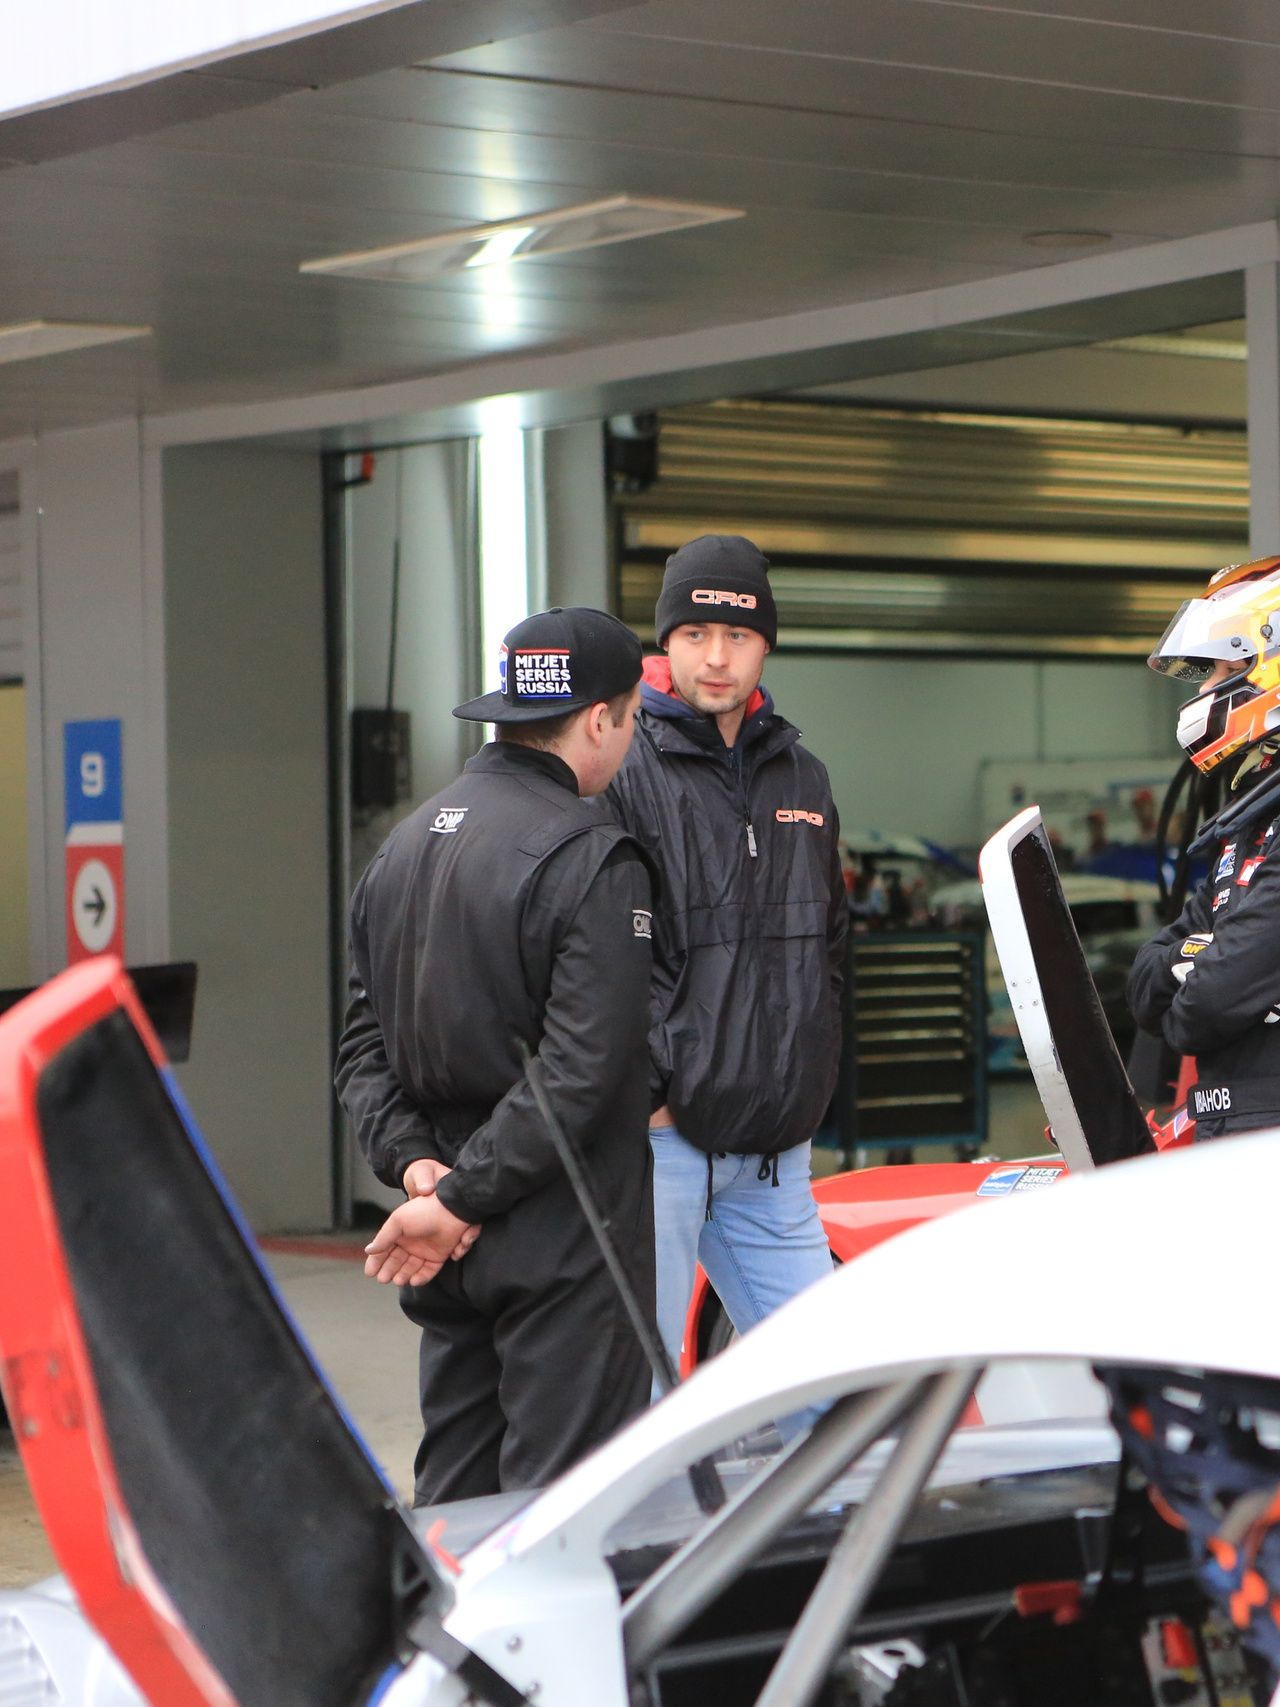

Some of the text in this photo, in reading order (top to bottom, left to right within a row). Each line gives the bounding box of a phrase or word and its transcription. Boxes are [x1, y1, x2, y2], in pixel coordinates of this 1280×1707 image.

[692, 589, 757, 610] CRG
[515, 655, 570, 669] MITJET
[515, 668, 572, 682] SERIES
[516, 682, 572, 694] RUSSIA
[80, 752, 104, 797] 9
[434, 812, 465, 829] OMP
[775, 809, 824, 827] CRG
[1026, 1168, 1063, 1176] MITJET
[1020, 1175, 1057, 1184] SERIES
